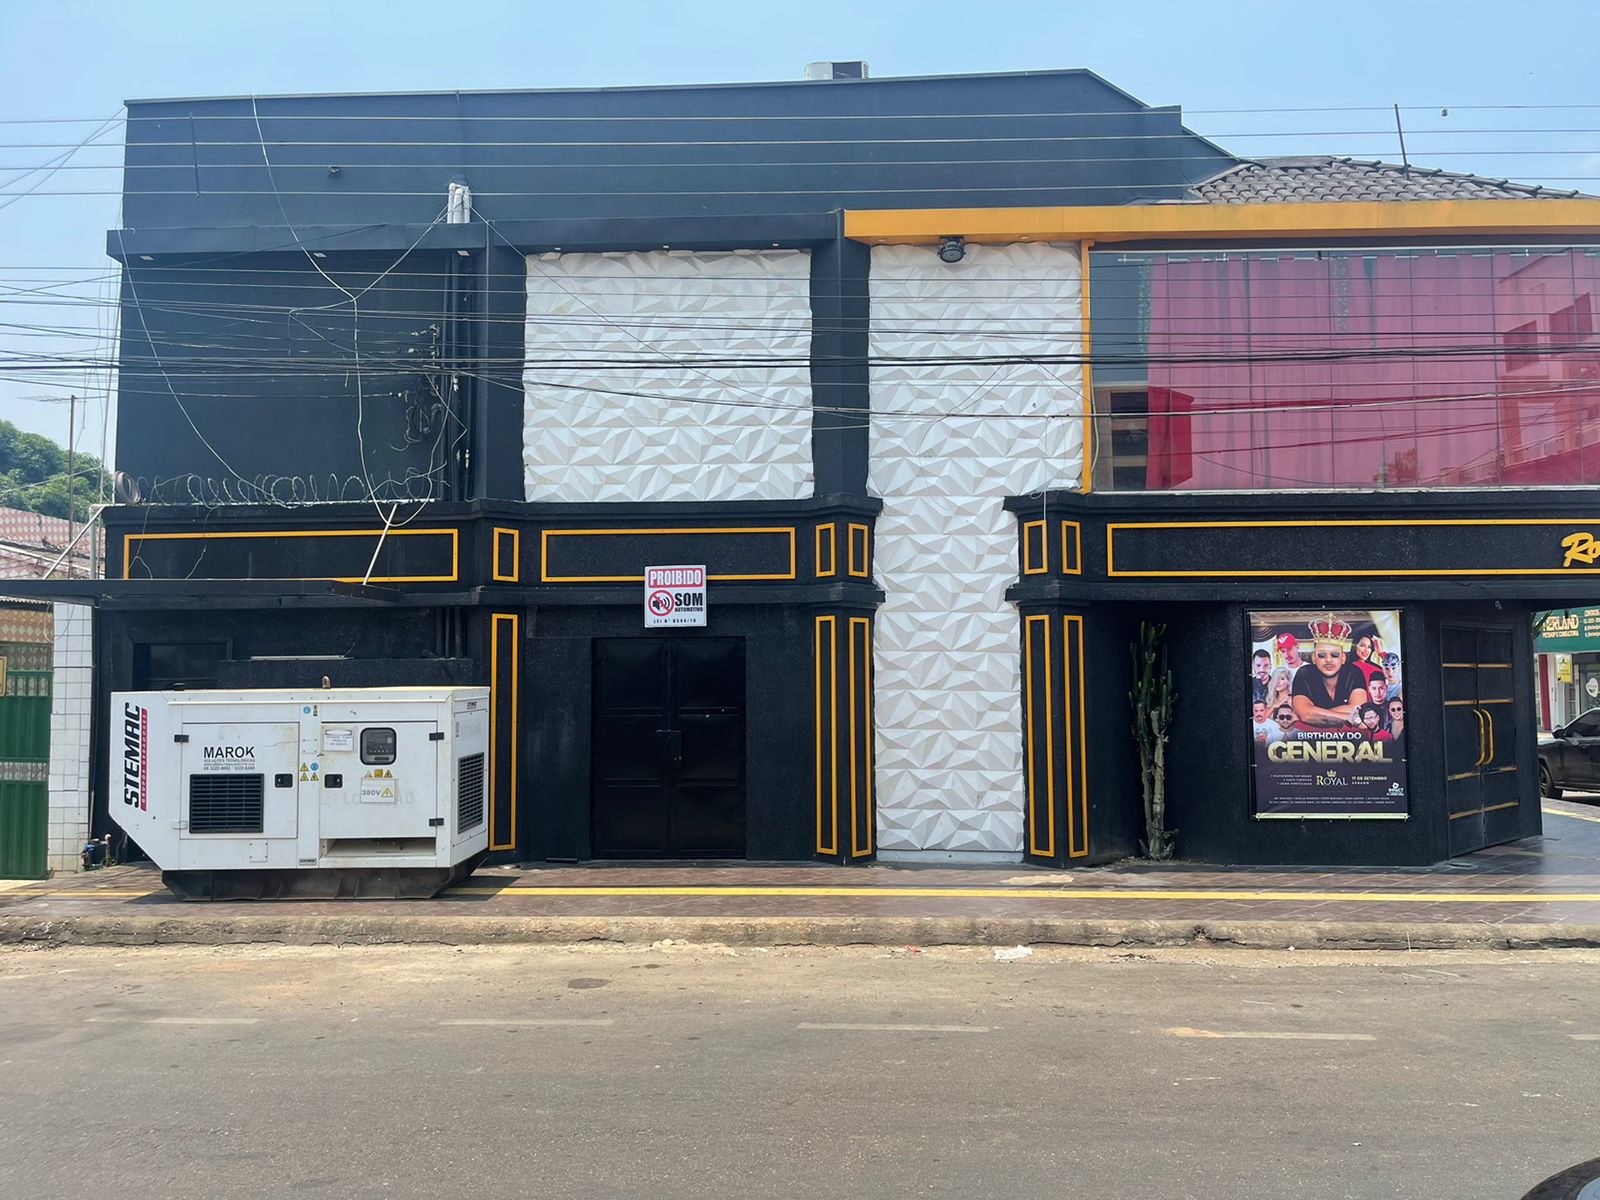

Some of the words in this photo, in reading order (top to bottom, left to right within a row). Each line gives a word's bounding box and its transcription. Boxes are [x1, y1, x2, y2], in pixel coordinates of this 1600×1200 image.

[650, 570, 701, 586] PROIBIDO
[674, 592, 703, 606] SOM
[1297, 732, 1344, 740] BIRTHDAY
[1346, 732, 1361, 740] DO
[124, 702, 140, 808] STEMAC
[203, 746, 255, 759] MAROK
[1267, 740, 1393, 763] GENERAL
[1316, 775, 1348, 786] ROYAL
[361, 789, 381, 797] 380V
